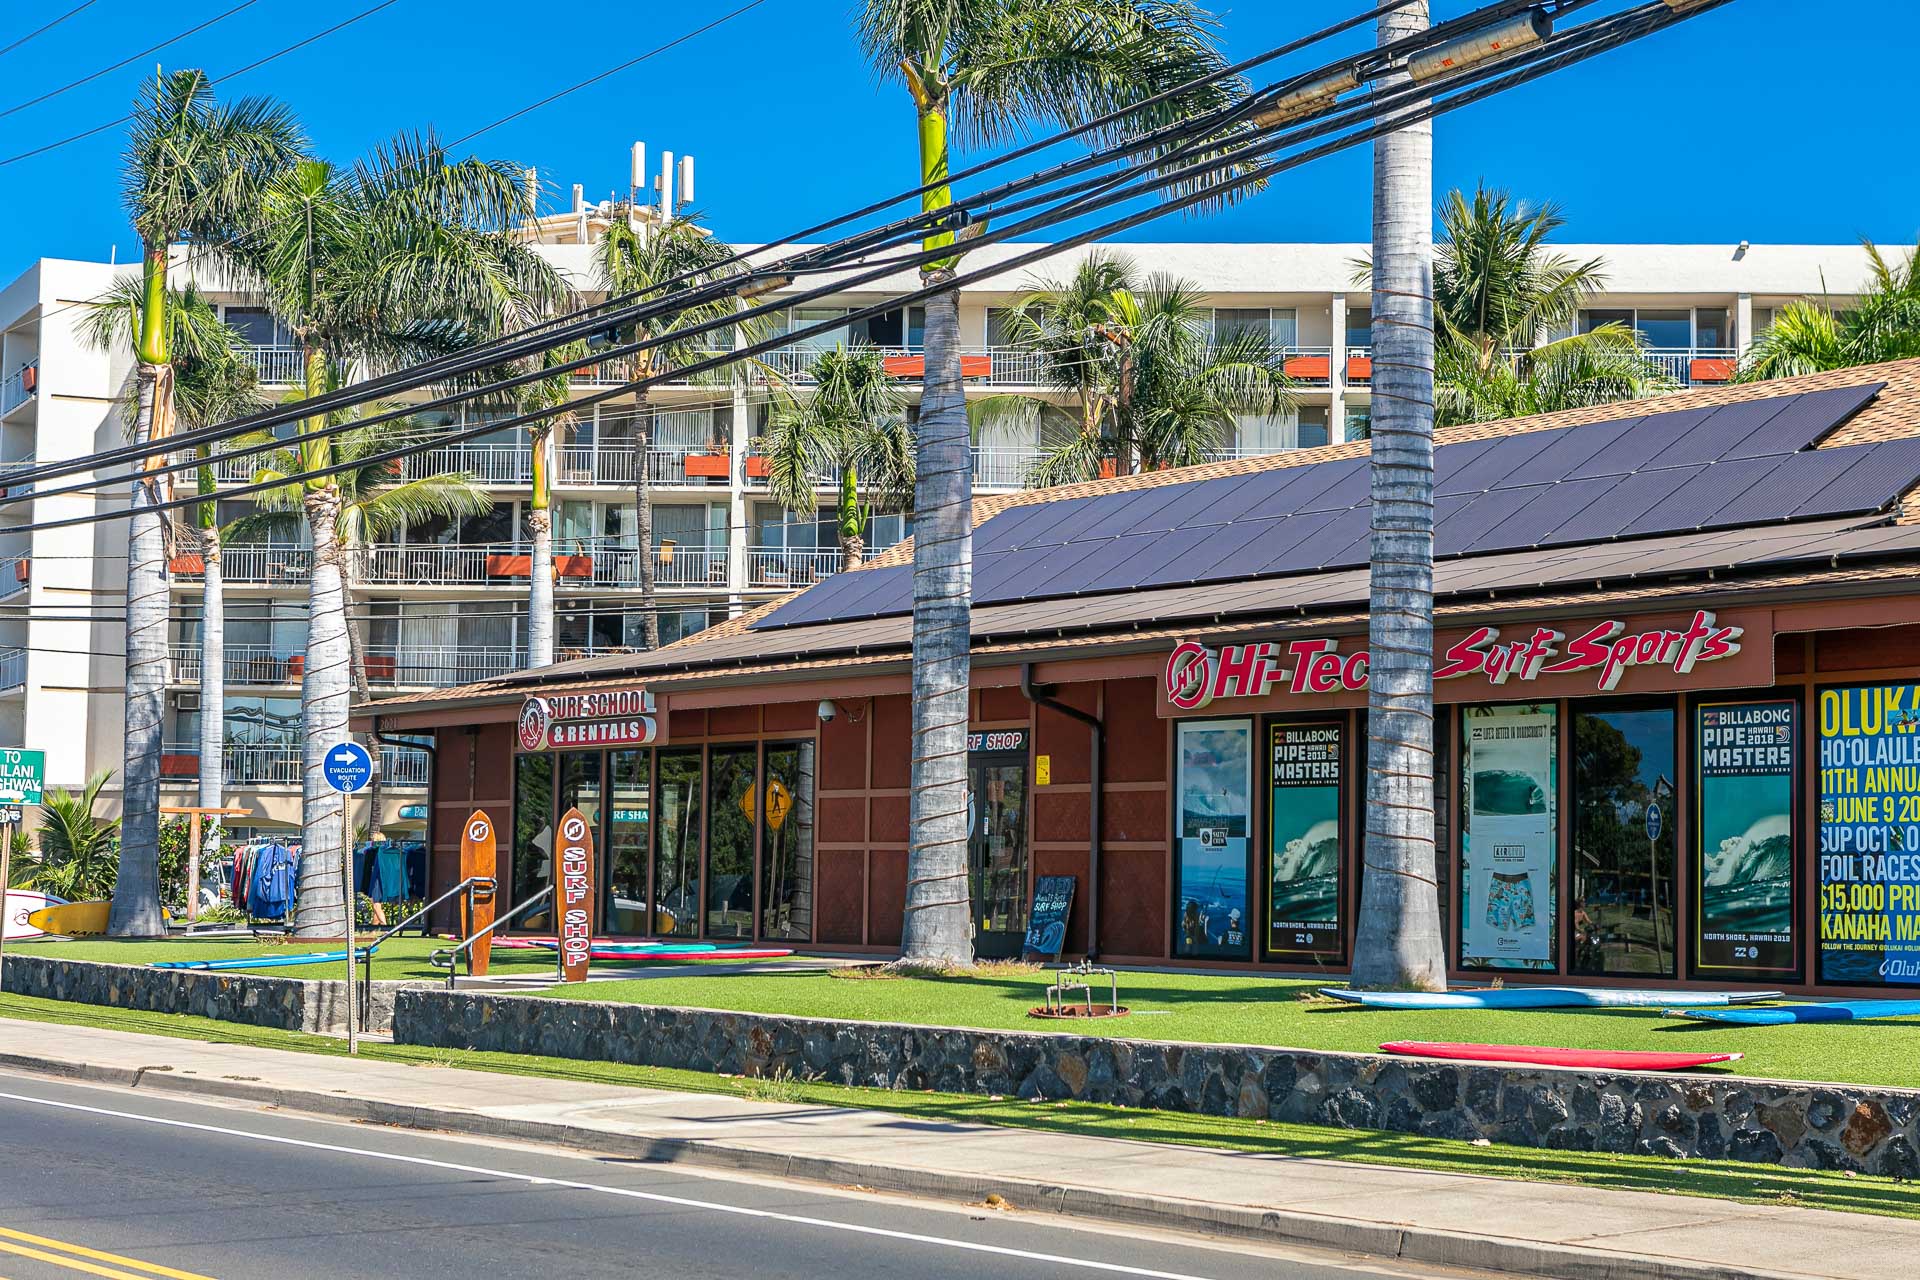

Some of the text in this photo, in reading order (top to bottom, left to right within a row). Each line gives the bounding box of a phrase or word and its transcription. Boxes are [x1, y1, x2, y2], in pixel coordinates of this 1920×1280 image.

[1211, 638, 1370, 699] Hi-Tec
[1539, 609, 1740, 691] Sports
[546, 690, 648, 720] SURF SCHOOL
[1719, 708, 1790, 725] BILLABONG
[553, 722, 640, 743] & RENTALS
[1286, 730, 1339, 743] BILLABONG
[1703, 728, 1746, 746] PIPE
[1747, 726, 1774, 735] HAWAII
[1748, 734, 1774, 745] 2018
[986, 732, 1023, 750] SHOP
[4, 751, 22, 764] TO
[1274, 745, 1306, 761] PIPE
[1307, 751, 1327, 760] 2018
[1703, 747, 1790, 767] MASTERS
[1274, 761, 1339, 779] MASTERS
[1821, 766, 1920, 794] 11TH ANNU
[613, 810, 649, 820] RF SHA
[1835, 795, 1920, 823] JUNE 9 20
[1821, 826, 1853, 852] SUP
[1855, 825, 1888, 852] OC1
[563, 847, 589, 904] SURF
[1821, 854, 1920, 881] FOIL RACES
[1821, 882, 1920, 913] $15,000 PRI
[1821, 913, 1892, 941] KANAHA
[563, 909, 590, 967] SHOP
[1703, 933, 1725, 941] NORTH
[1749, 934, 1773, 942] HAWAII
[1773, 935, 1791, 943] 2018
[1843, 943, 1853, 951] THE
[1854, 943, 1878, 951] JOURNEY
